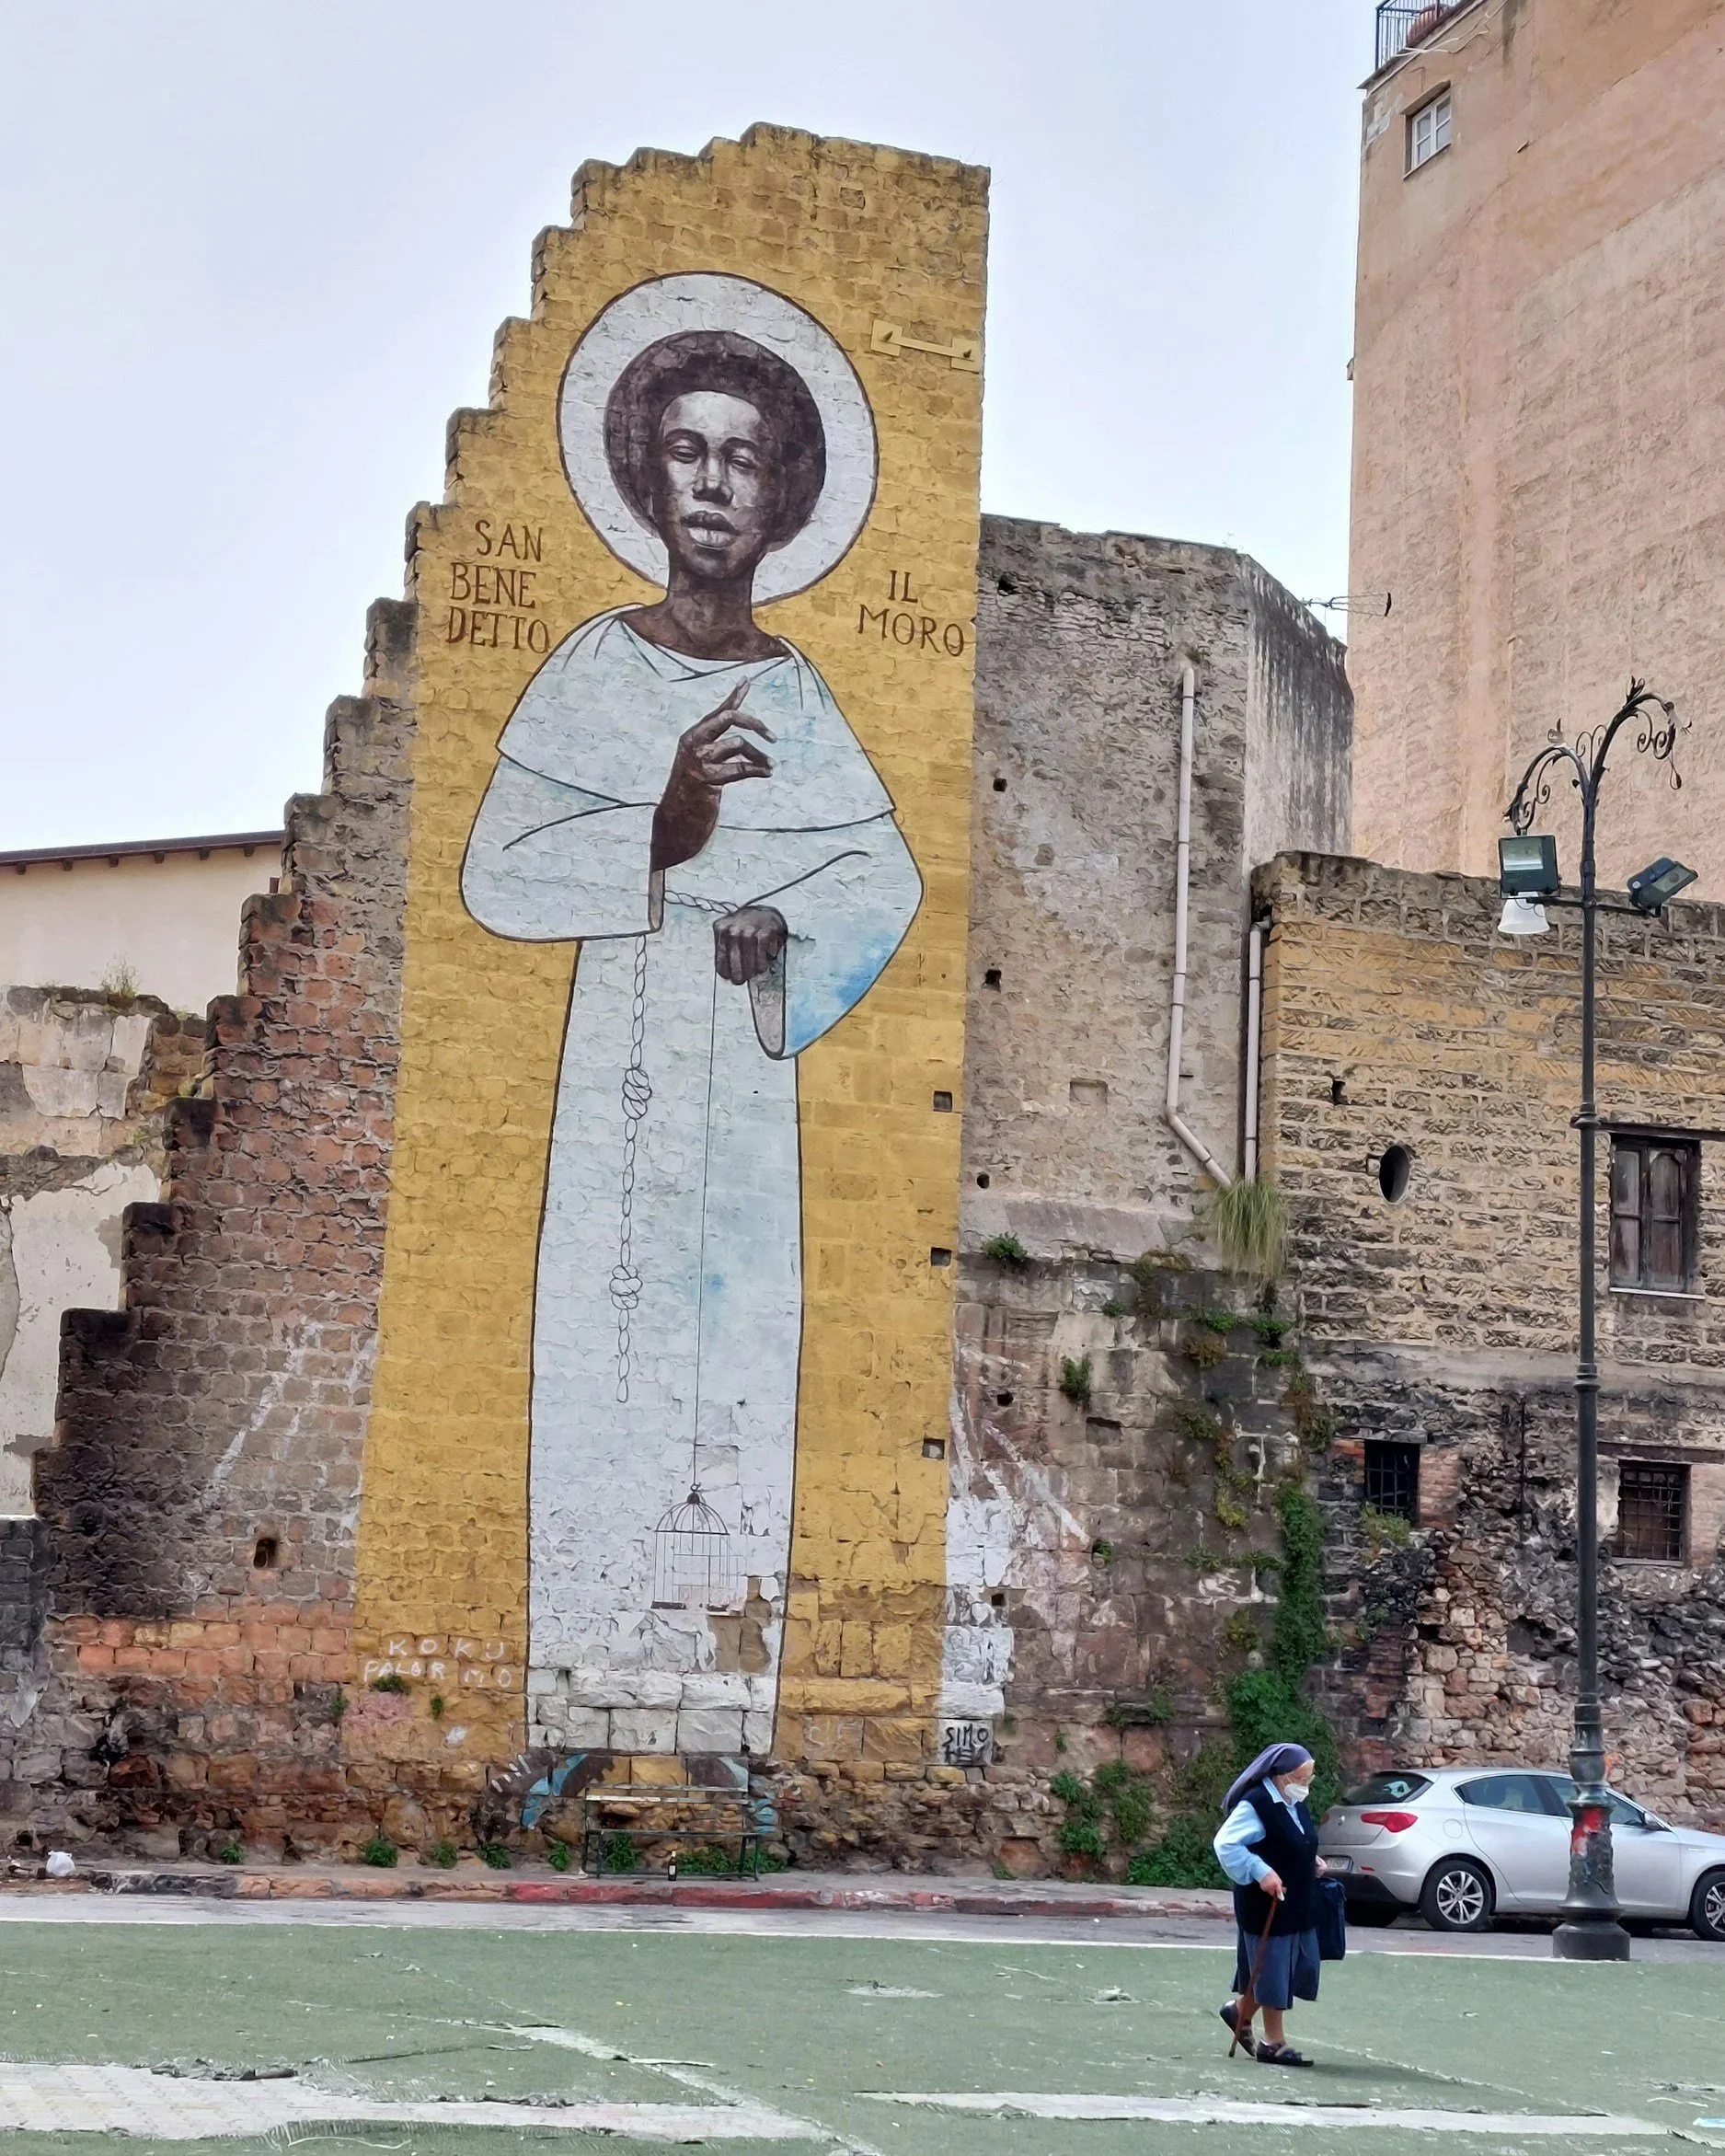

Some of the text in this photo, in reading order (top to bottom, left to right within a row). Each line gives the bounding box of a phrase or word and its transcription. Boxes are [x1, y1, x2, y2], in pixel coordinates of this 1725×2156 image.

[475, 519, 544, 562] SAN
[450, 561, 536, 609] BENE
[888, 570, 918, 604] IL
[445, 605, 551, 654] DETTO
[857, 604, 964, 657] MORO
